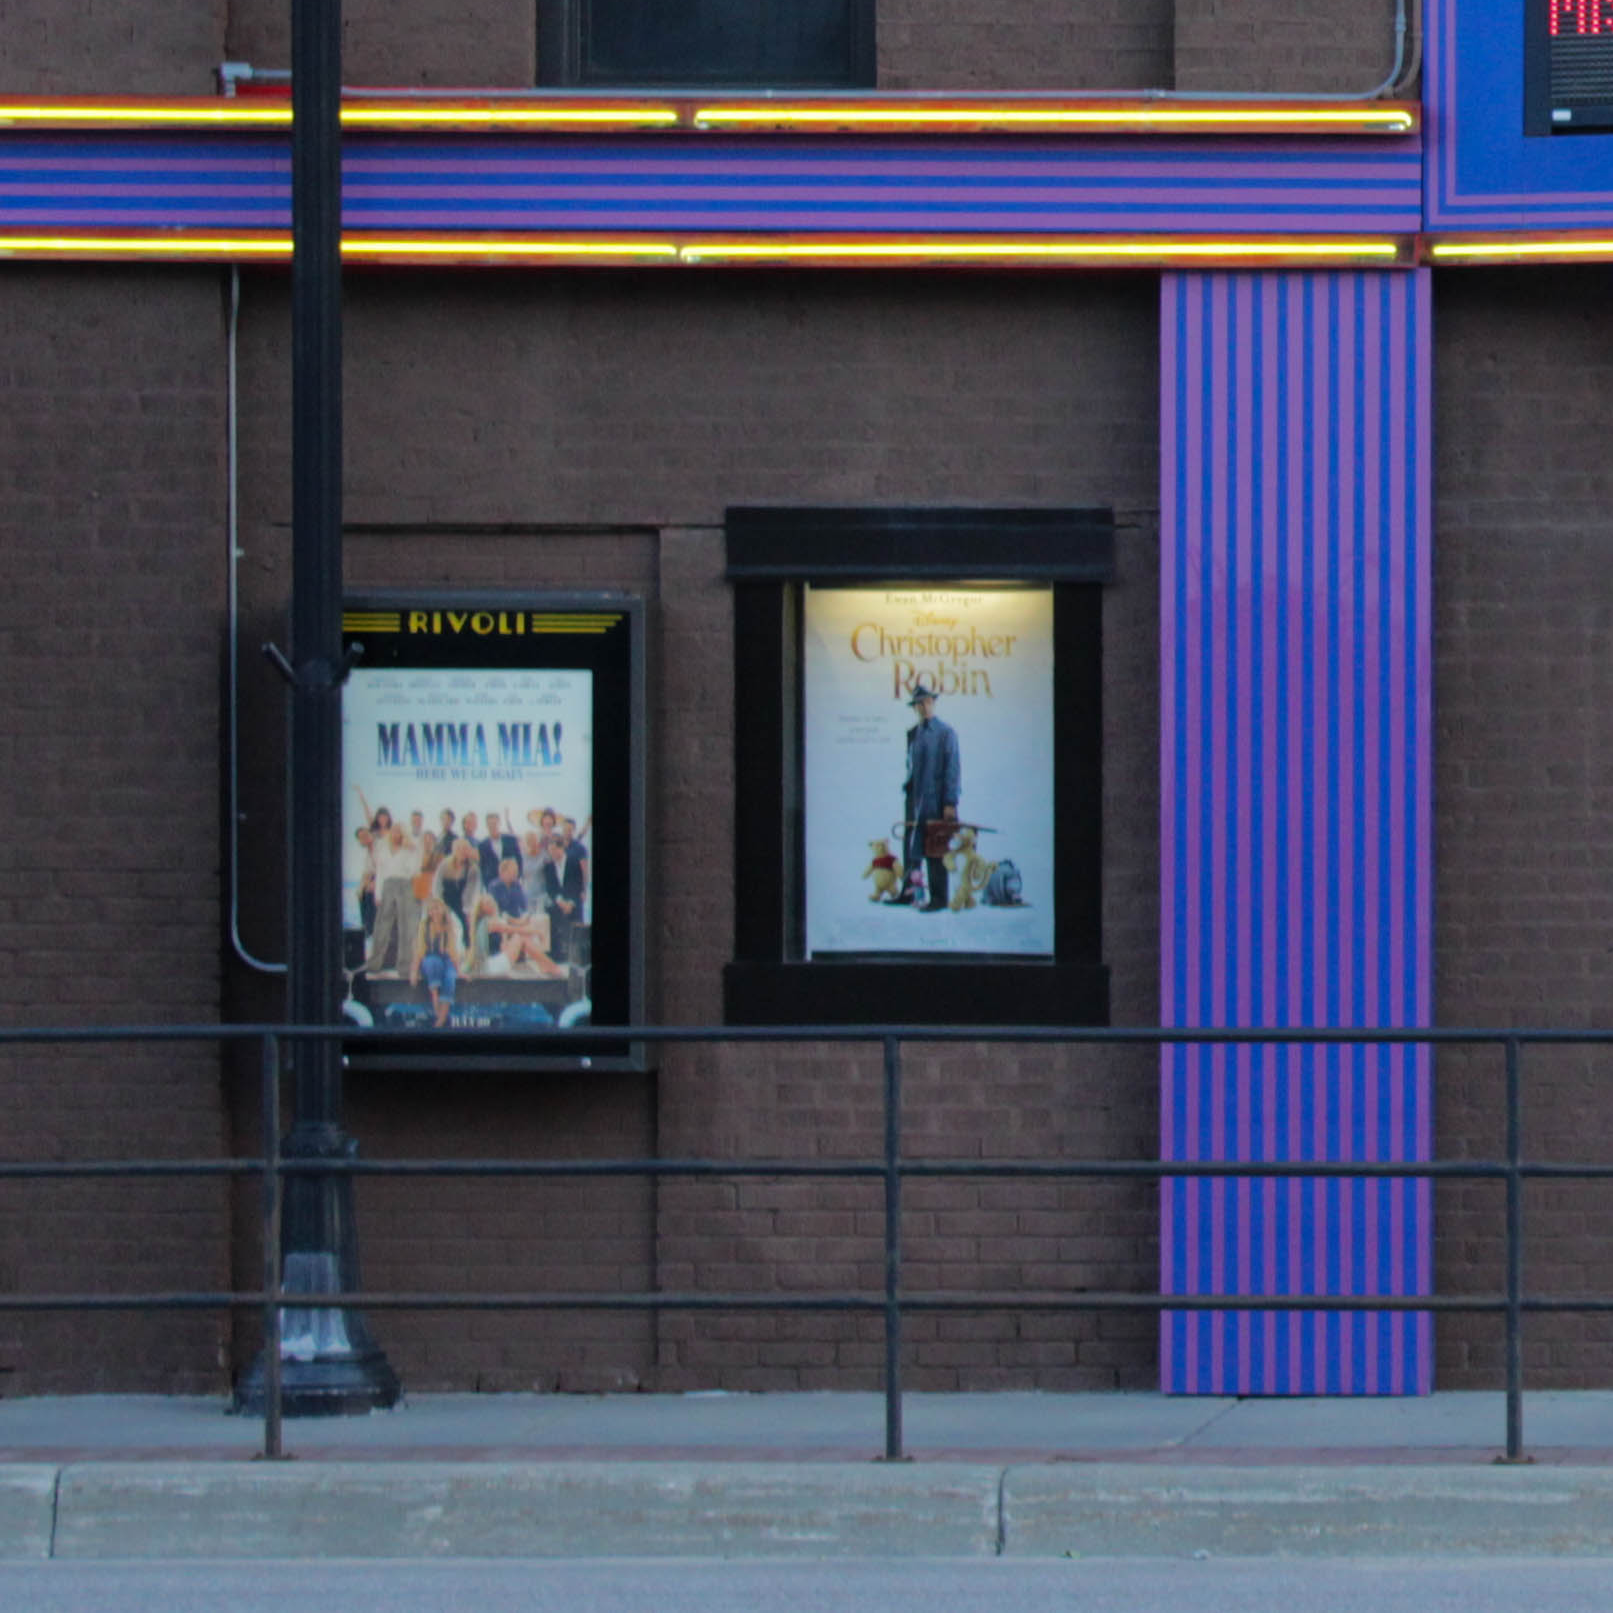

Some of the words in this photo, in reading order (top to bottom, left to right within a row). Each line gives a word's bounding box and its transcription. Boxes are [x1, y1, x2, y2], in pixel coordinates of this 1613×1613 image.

[408, 611, 525, 634] RIVOLI
[851, 622, 1017, 667] Christopher
[894, 659, 994, 699] Robin
[377, 721, 491, 767] MAMMA
[497, 721, 563, 767] MIA!
